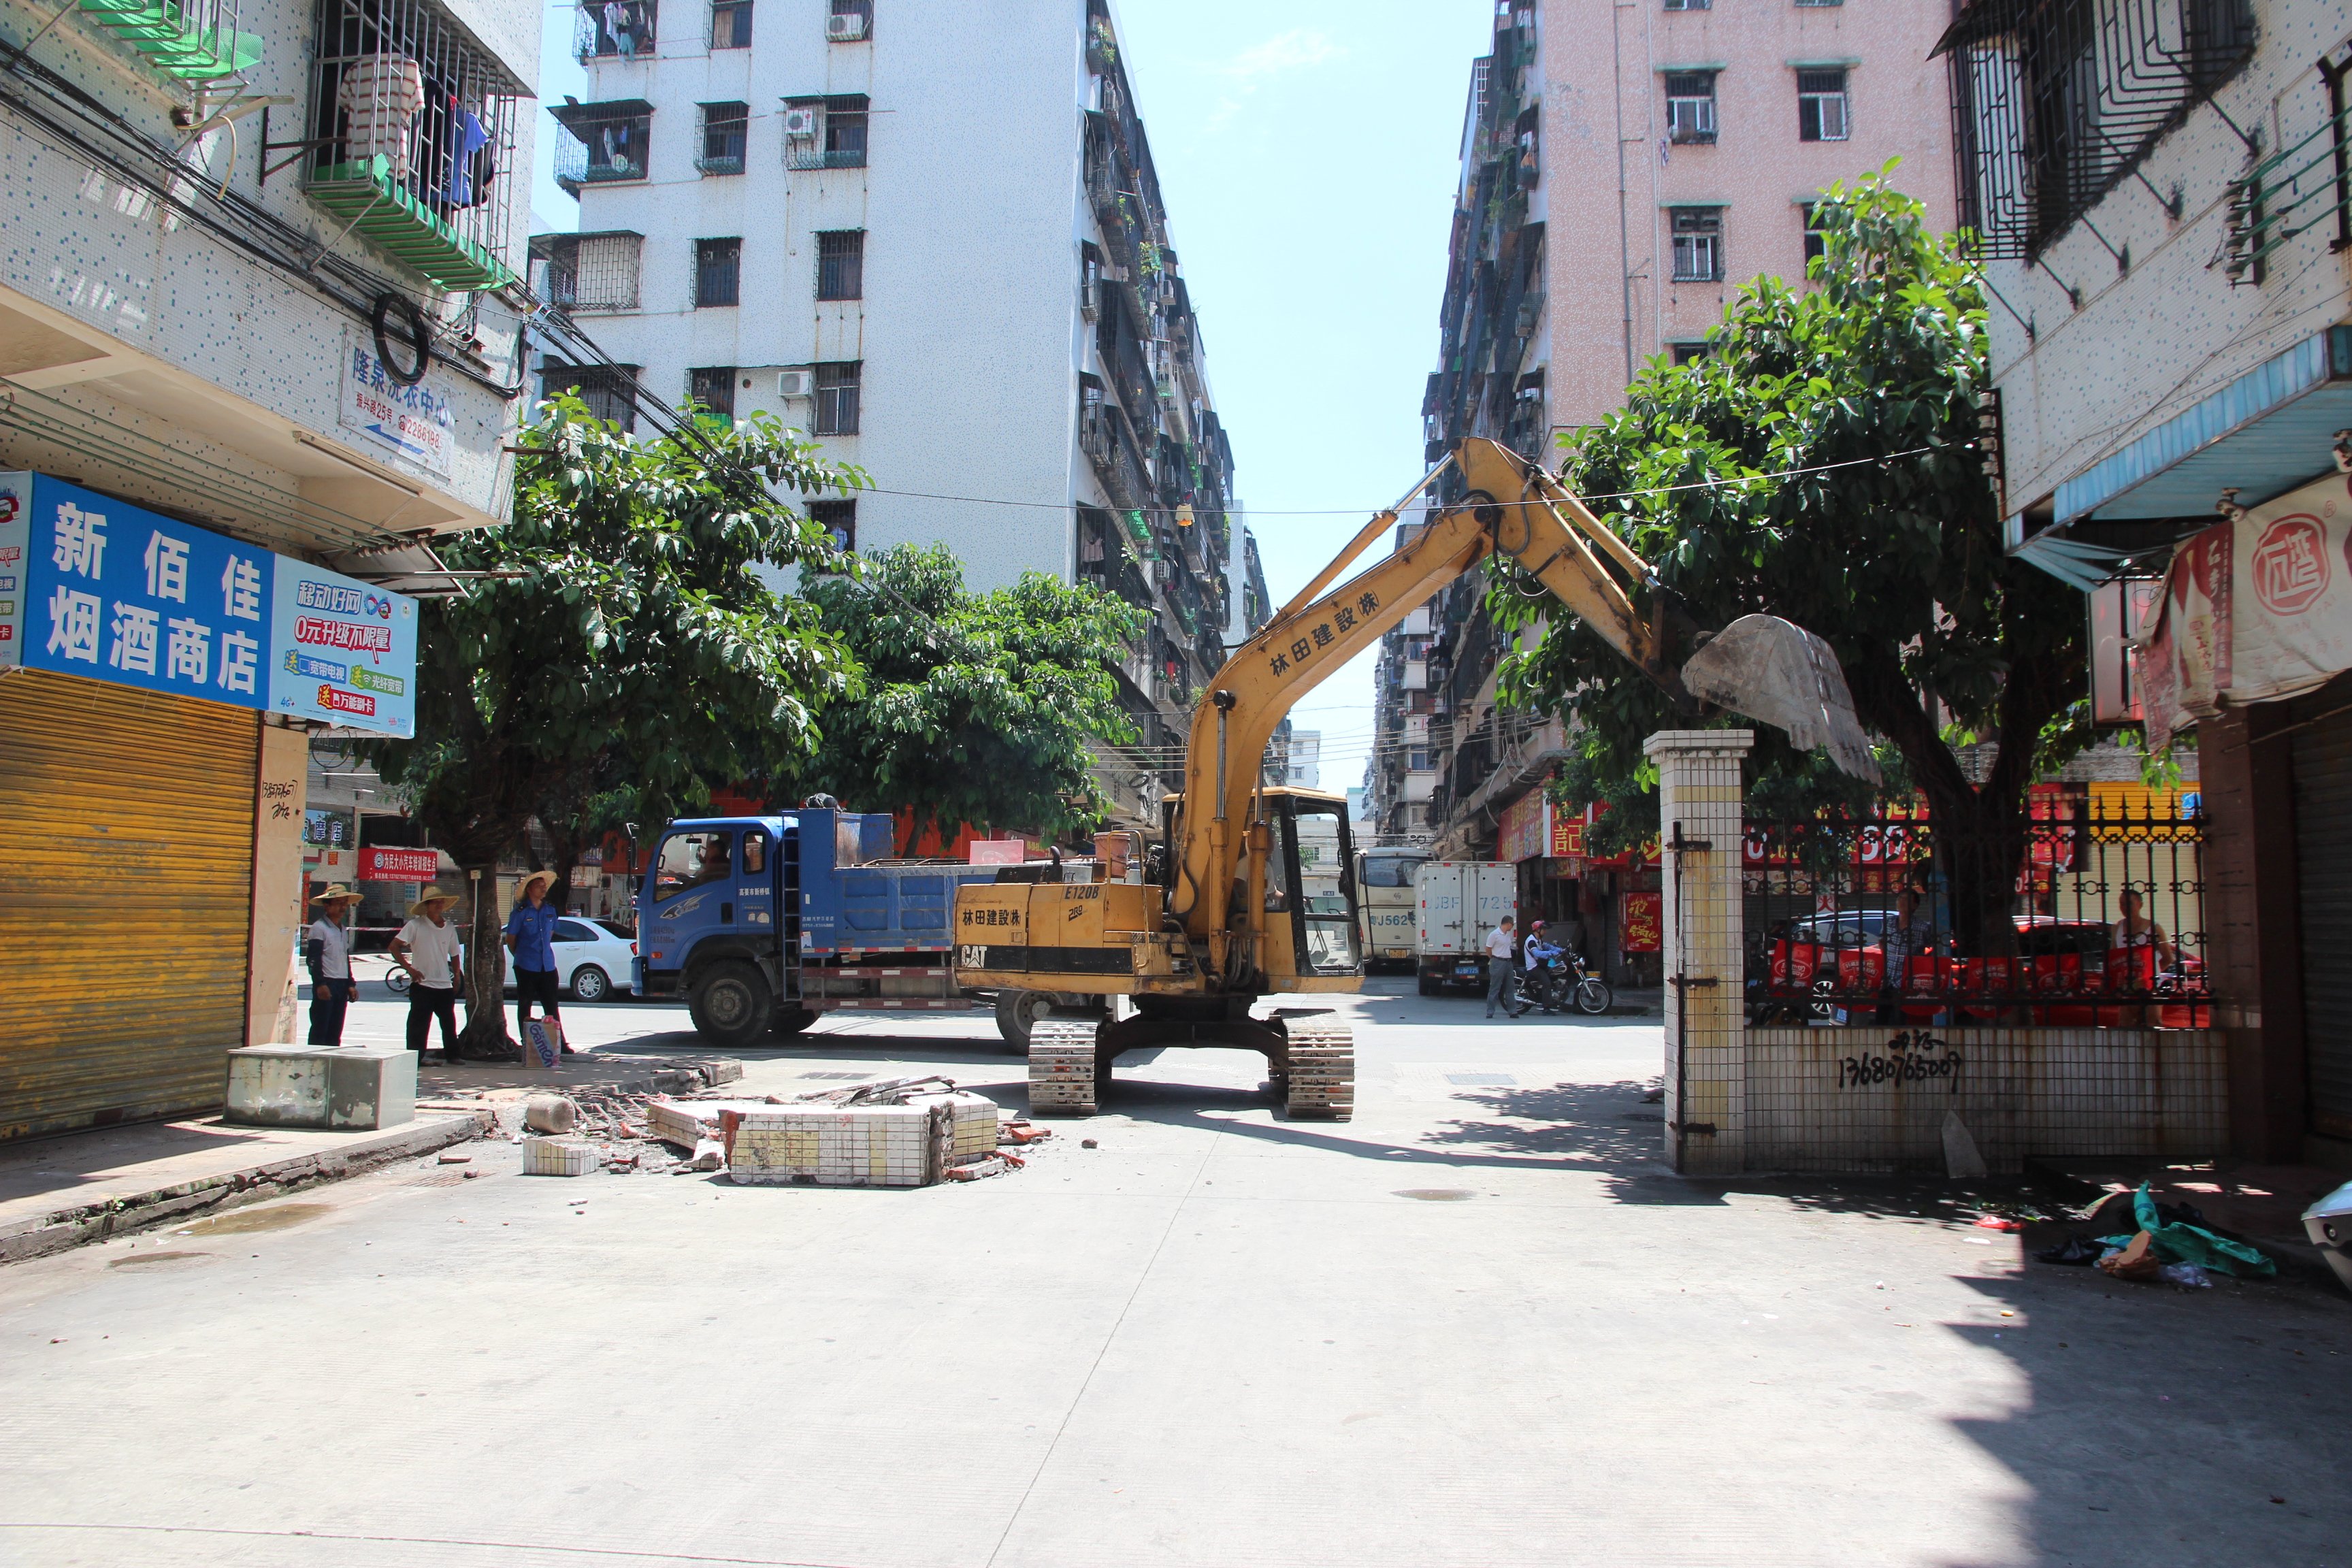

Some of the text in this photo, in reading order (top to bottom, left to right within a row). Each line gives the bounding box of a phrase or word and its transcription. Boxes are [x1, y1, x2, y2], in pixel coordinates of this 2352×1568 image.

[357, 392, 393, 424] 振兴路25号
[52, 502, 261, 622] 新佰佳
[297, 581, 362, 614] 移动好网
[47, 586, 261, 696] 烟酒商店
[295, 616, 390, 662] 0元升级不限量
[284, 649, 345, 681] 送 宽带电视
[350, 665, 403, 694] 送 光纤宽带
[318, 685, 374, 713] 送 万能副卡
[739, 887, 770, 896] 高要市新桥镇
[1064, 885, 1100, 900] E120B
[961, 945, 987, 968] CAT
[1839, 1051, 1961, 1095] 13680765009
